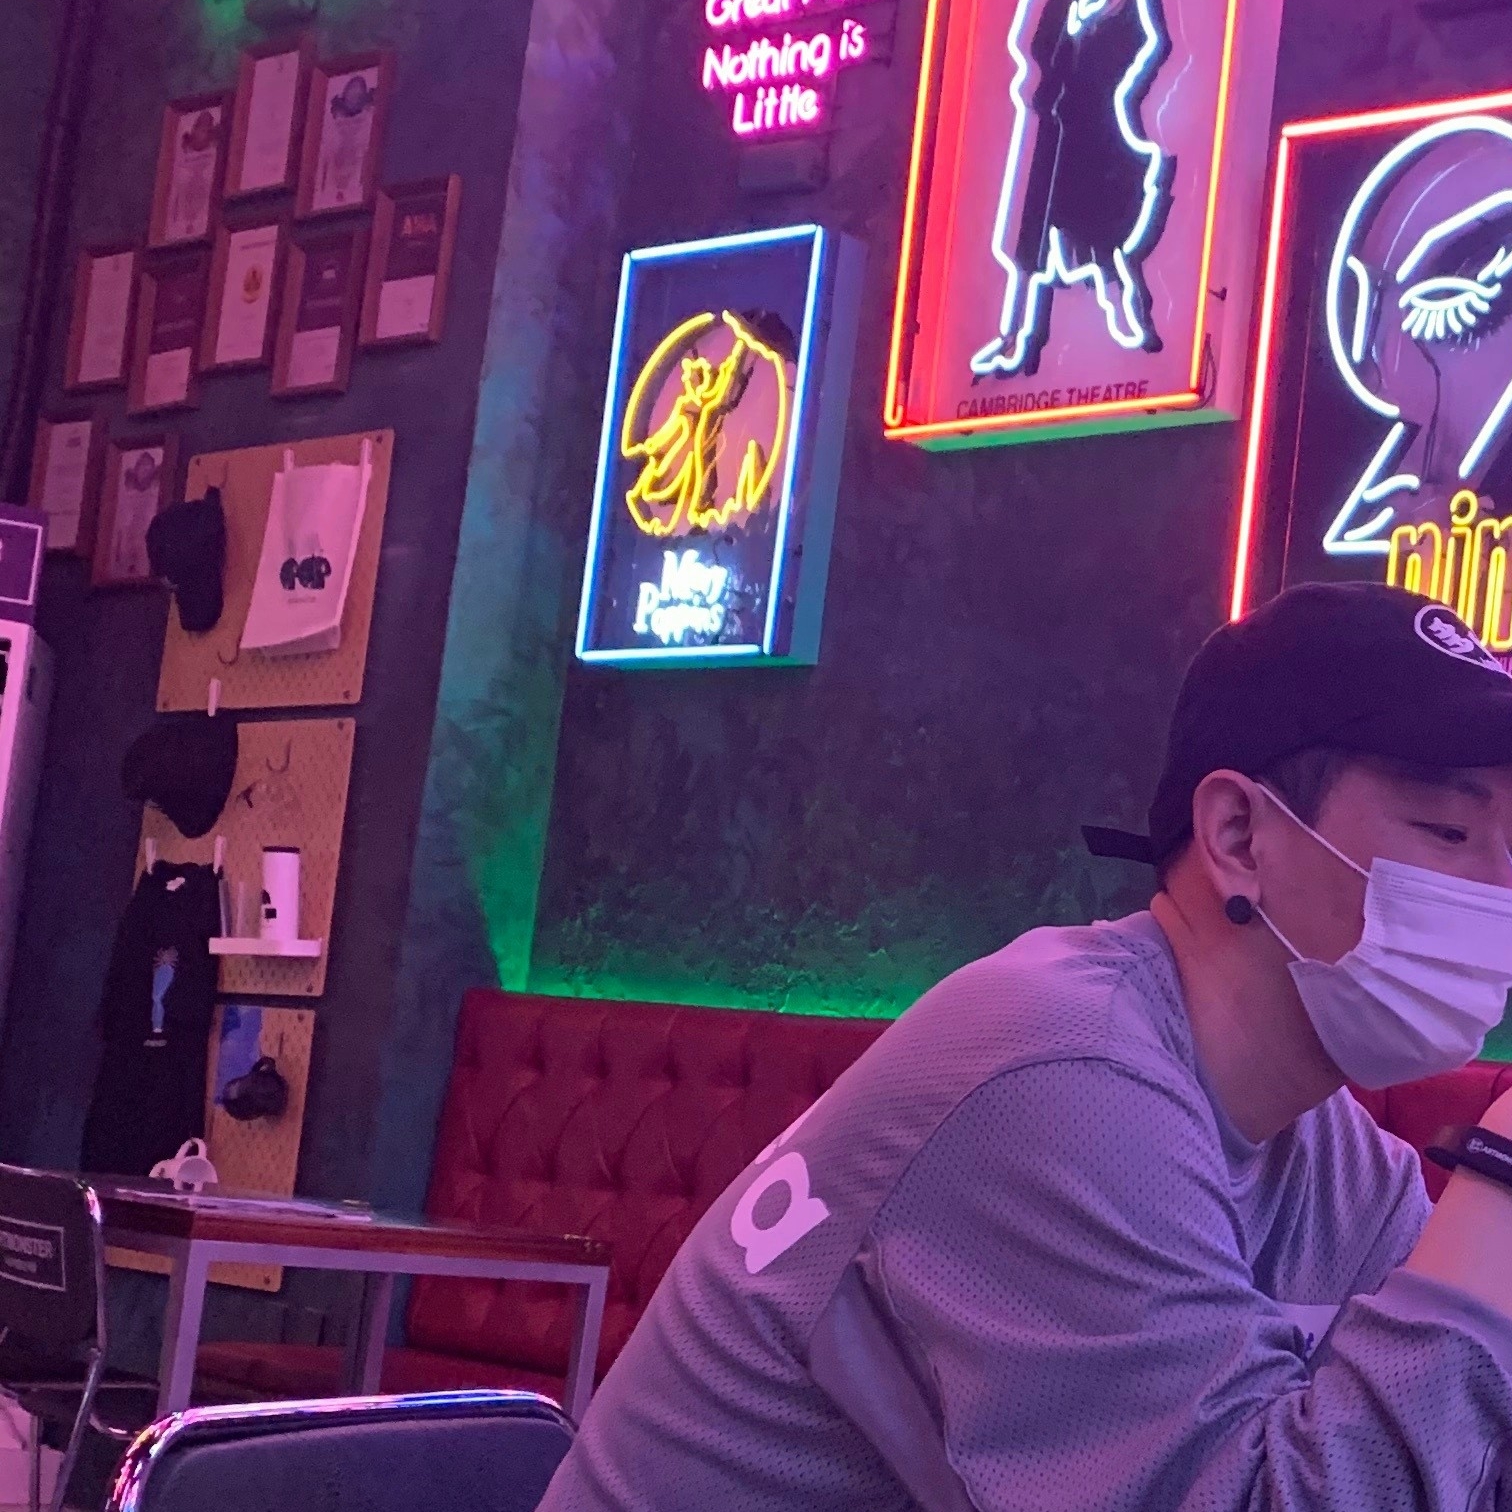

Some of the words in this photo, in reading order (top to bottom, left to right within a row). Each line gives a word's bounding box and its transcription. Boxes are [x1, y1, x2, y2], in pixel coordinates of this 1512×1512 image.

[702, 32, 832, 90] Nothing
[838, 19, 867, 61] is
[732, 83, 821, 135] Little
[956, 388, 1062, 420] CAMBRIDGE
[1066, 378, 1150, 408] THEATRE
